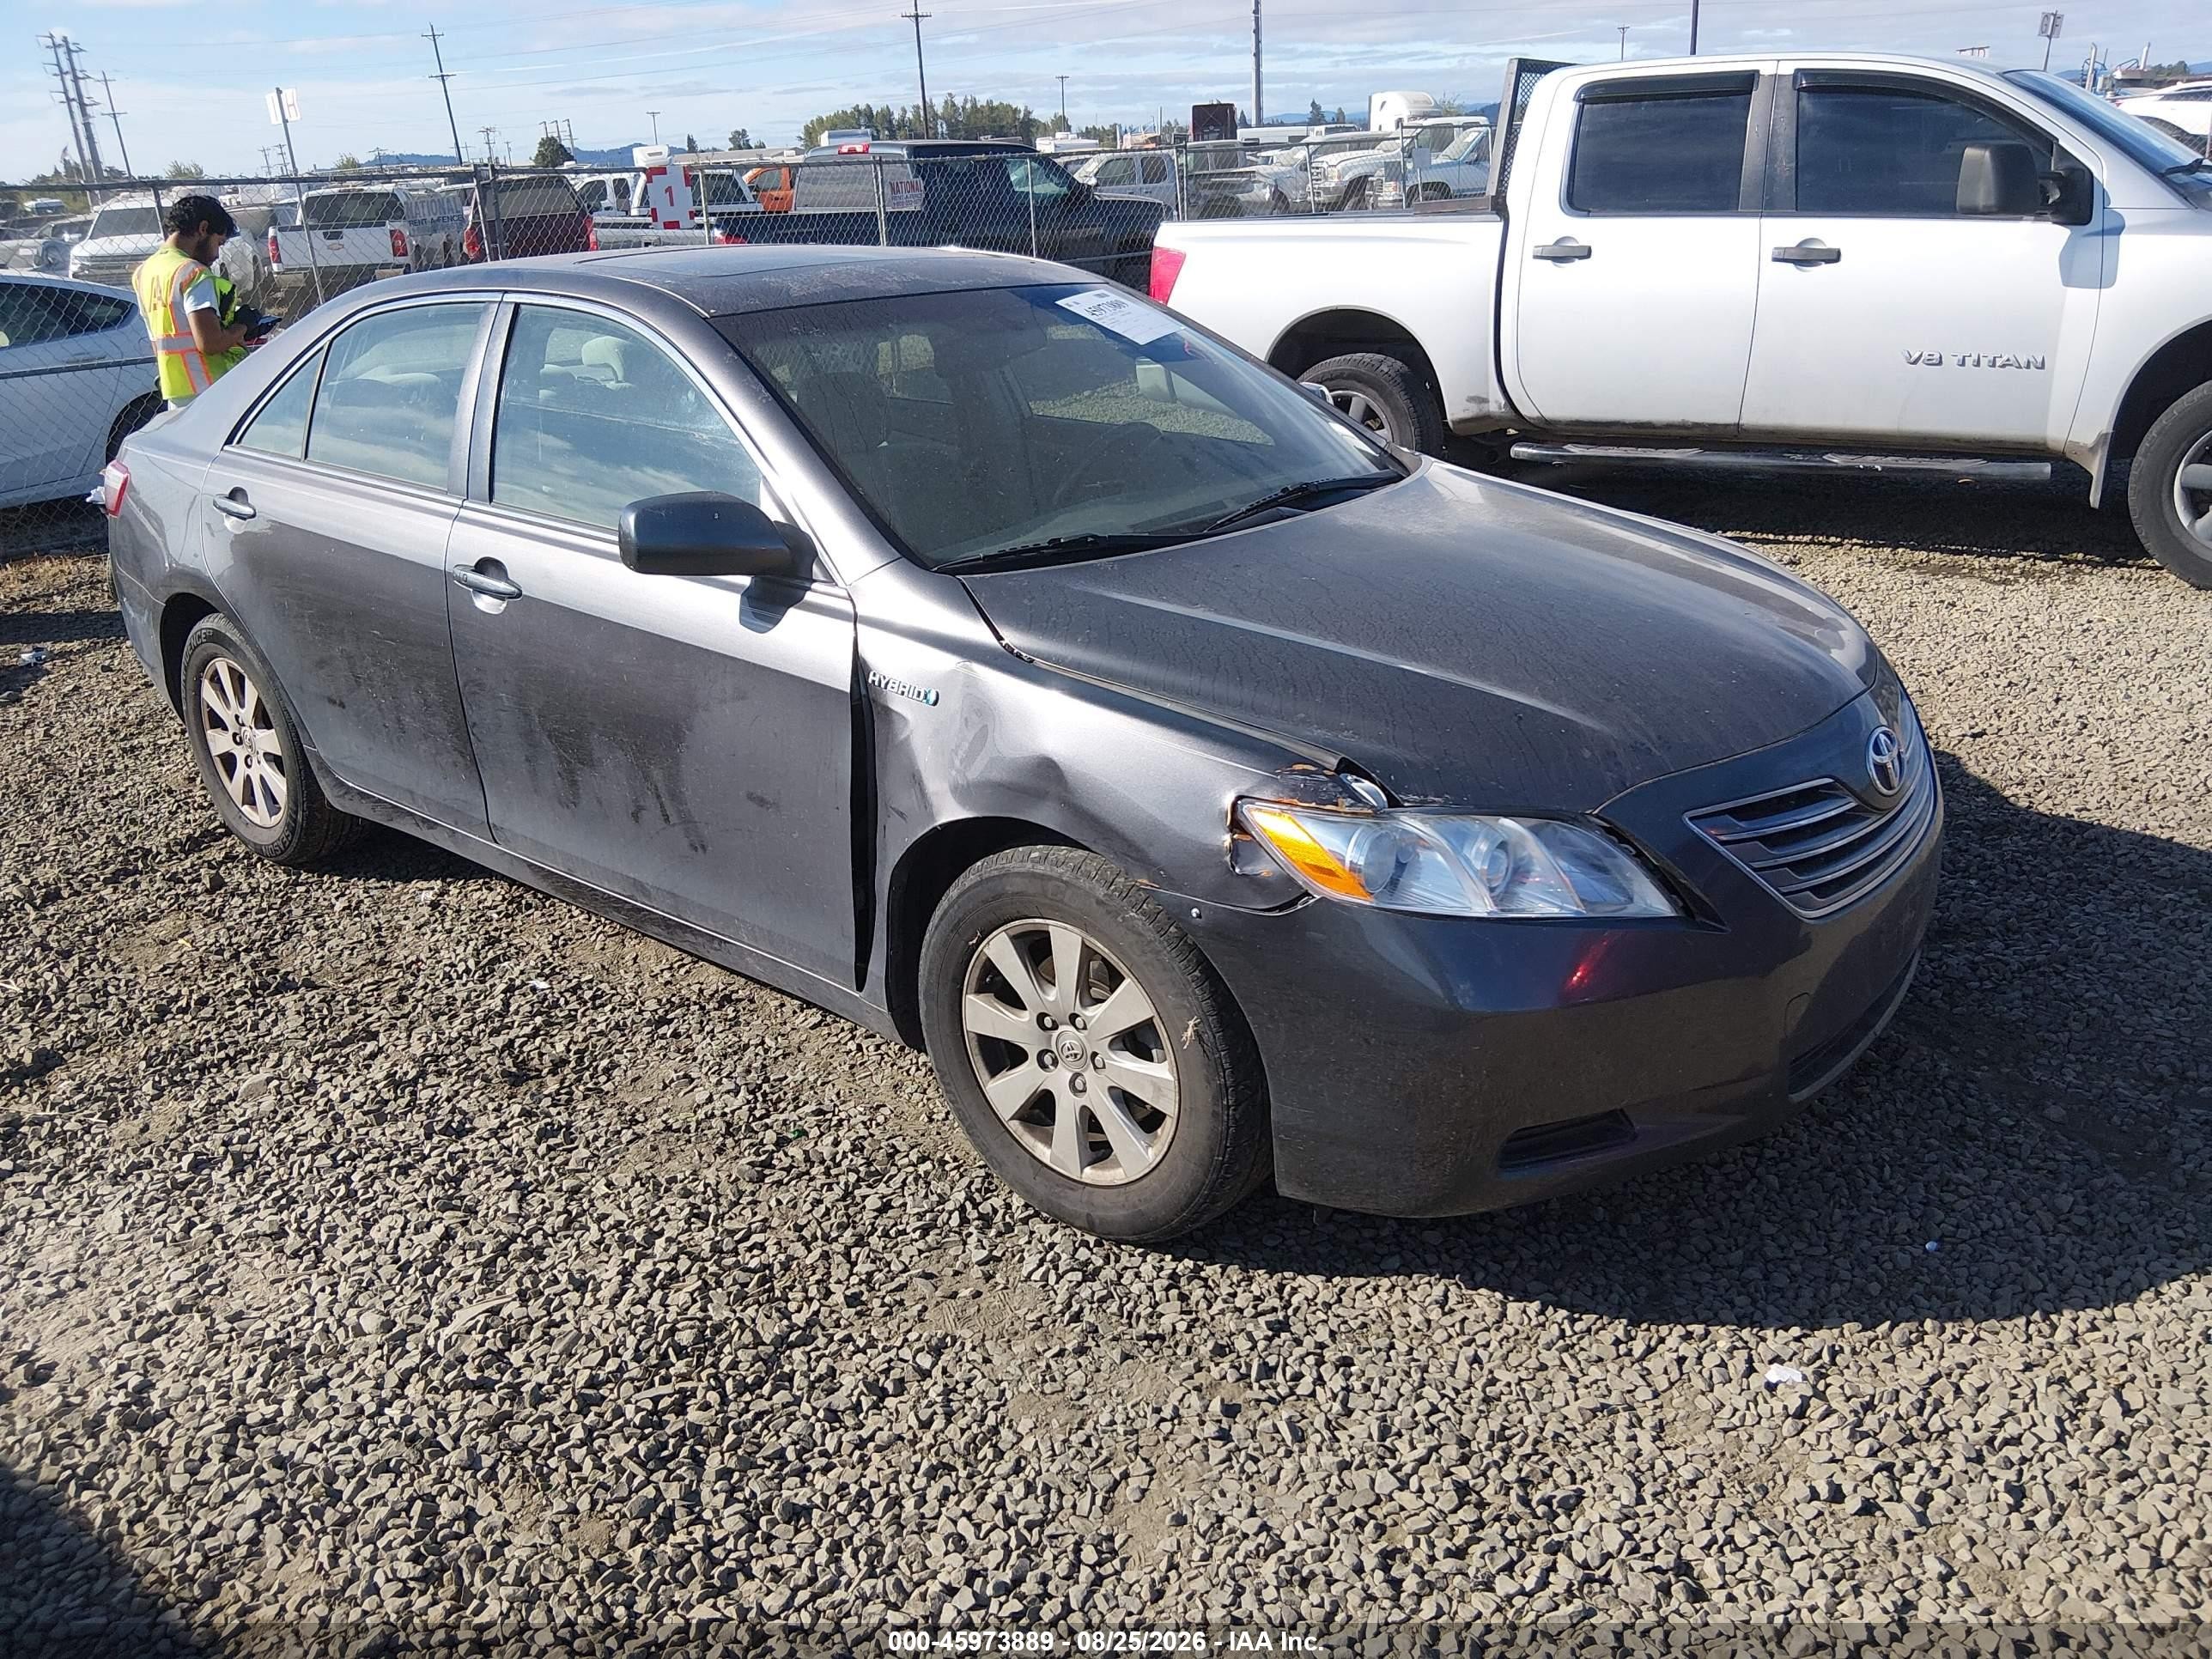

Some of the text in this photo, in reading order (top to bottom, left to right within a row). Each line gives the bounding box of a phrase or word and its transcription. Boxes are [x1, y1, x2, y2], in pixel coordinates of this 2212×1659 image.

[665, 185, 675, 207] 1
[890, 179, 922, 195] NATIONAL
[404, 197, 462, 219] NATIONAL
[1902, 349, 2046, 371] V8 TITAN
[867, 670, 925, 703] HYBRID
